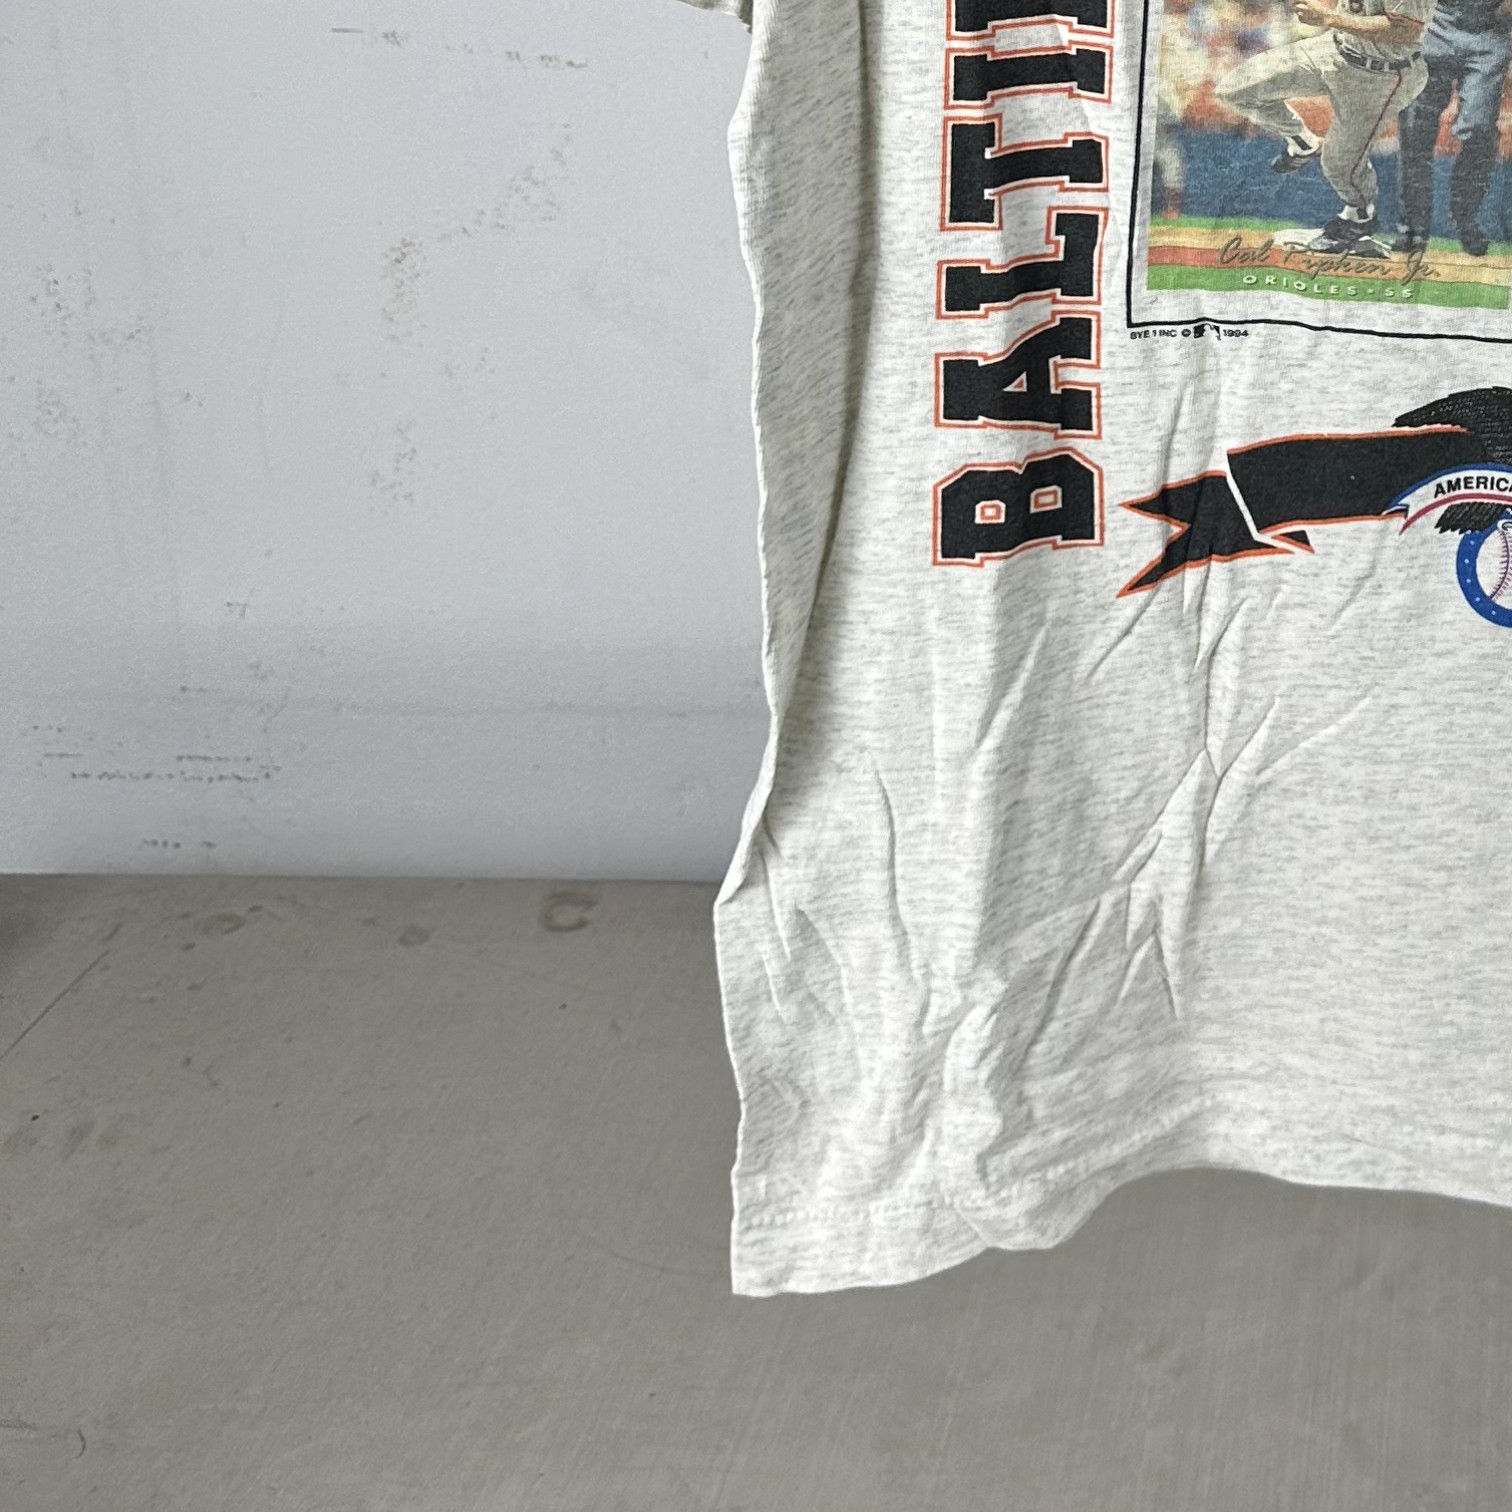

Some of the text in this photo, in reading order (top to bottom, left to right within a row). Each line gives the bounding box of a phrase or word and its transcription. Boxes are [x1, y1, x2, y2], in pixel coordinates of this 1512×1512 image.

[1217, 237, 1270, 266] Cal
[1400, 250, 1441, 286] Jr.
[1222, 329, 1249, 338] 1994
